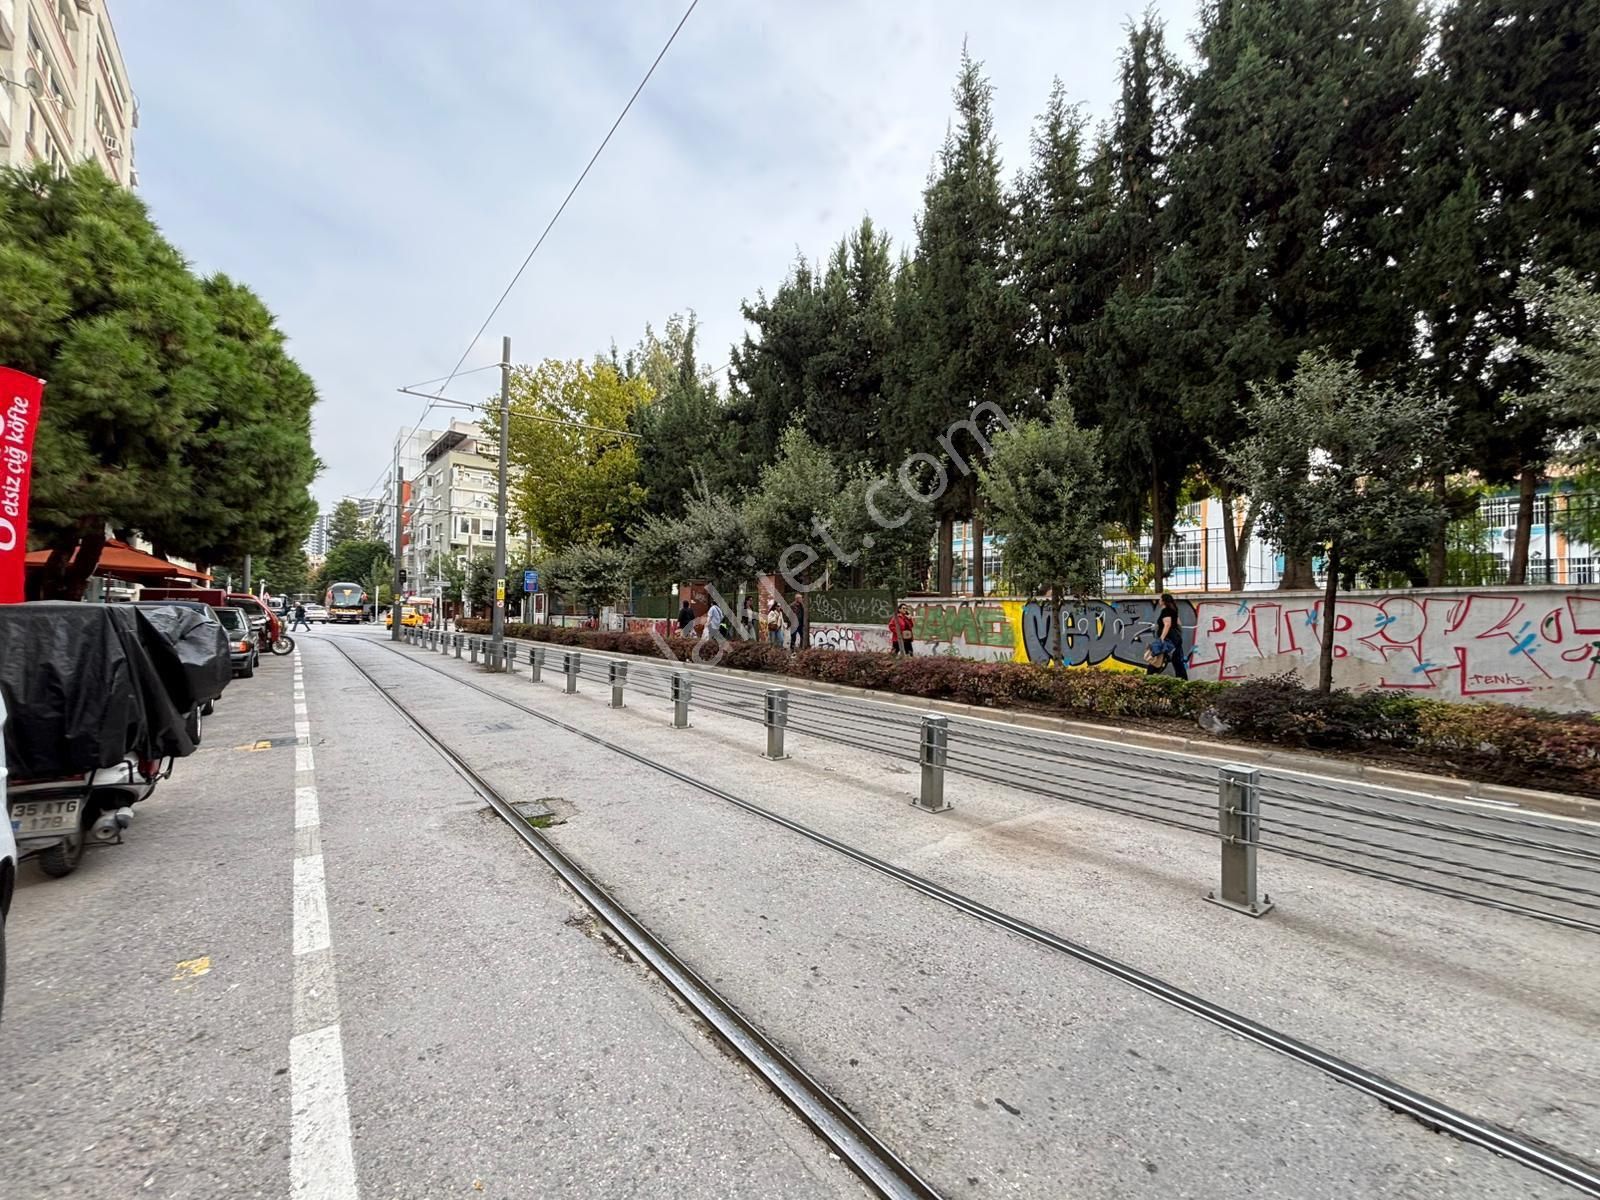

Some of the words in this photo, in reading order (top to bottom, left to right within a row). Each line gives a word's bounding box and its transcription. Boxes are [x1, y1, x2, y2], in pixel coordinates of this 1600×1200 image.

[4, 396, 29, 444] köfte
[3, 445, 27, 474] çiğ
[2, 475, 21, 517] etsiz
[14, 804, 38, 817] 35
[43, 800, 77, 815] ATG
